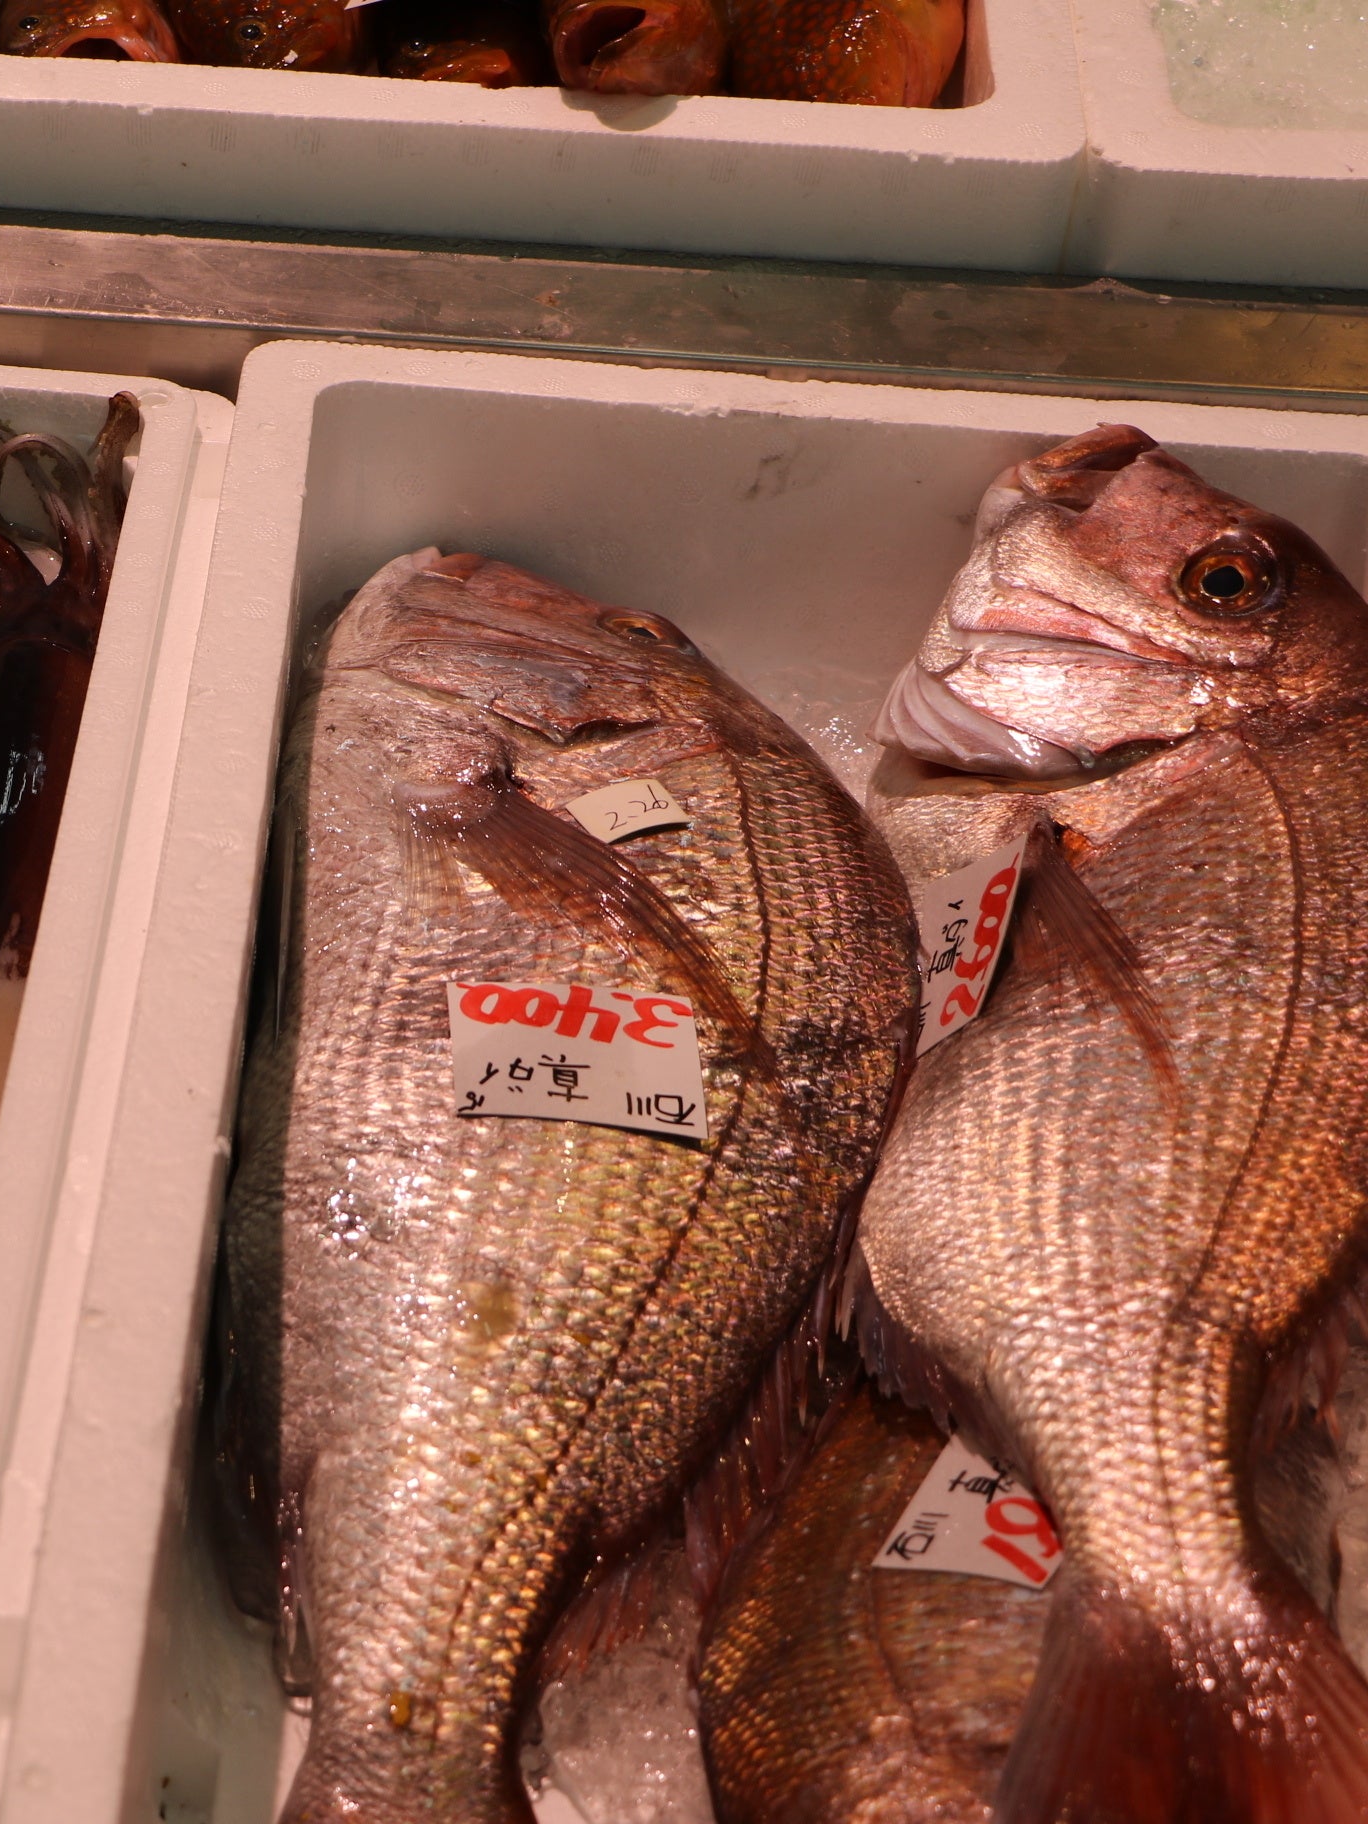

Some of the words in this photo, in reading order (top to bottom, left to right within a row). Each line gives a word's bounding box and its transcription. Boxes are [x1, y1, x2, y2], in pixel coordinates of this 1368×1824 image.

[480, 1054, 591, 1102] 真ダイ
[627, 1092, 696, 1126] 石川
[886, 1512, 950, 1561] 石川
